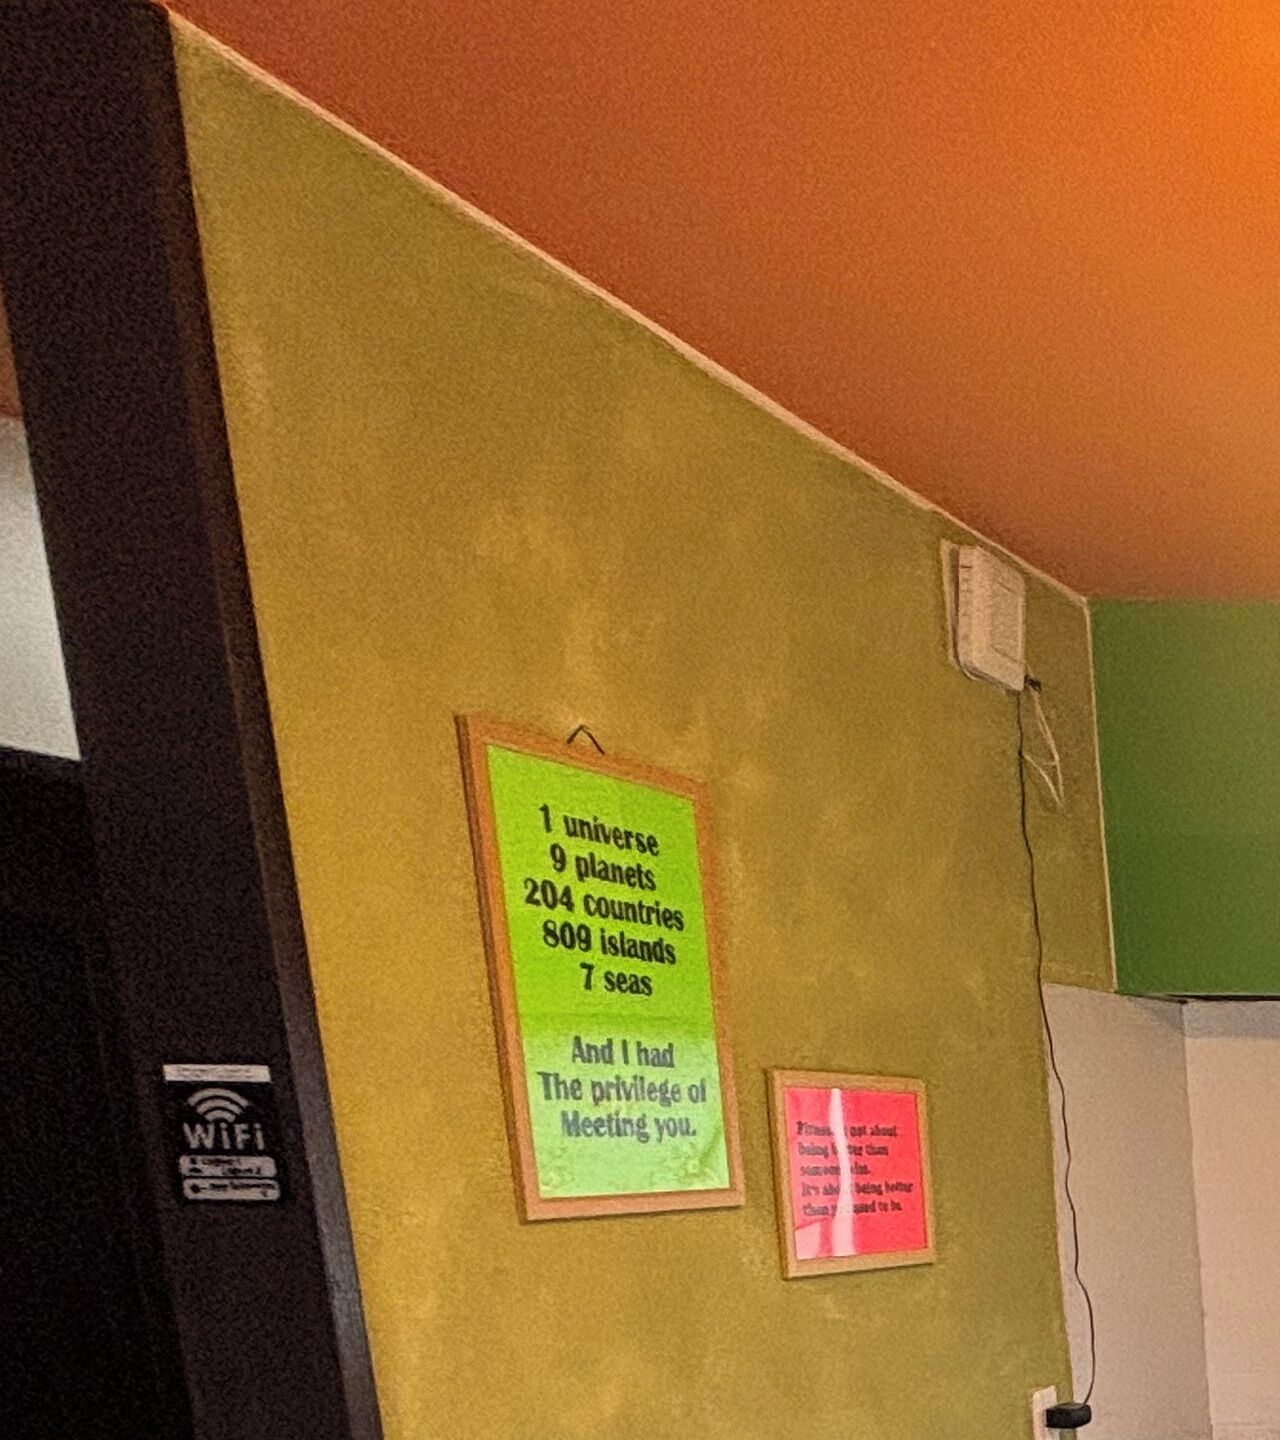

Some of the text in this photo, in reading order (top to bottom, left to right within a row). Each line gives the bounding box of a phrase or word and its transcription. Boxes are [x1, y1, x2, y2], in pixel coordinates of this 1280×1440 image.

[539, 804, 659, 856] 1 universe
[551, 843, 656, 891] 9 planets
[524, 878, 684, 931] 204 countries
[543, 920, 676, 964] 809 islands
[580, 963, 652, 995] 7 seas
[572, 1036, 674, 1068] And I had
[538, 1072, 582, 1100] The
[591, 1075, 681, 1107] privilege
[182, 1122, 265, 1150] WiFi
[561, 1110, 696, 1143] Meeting you.
